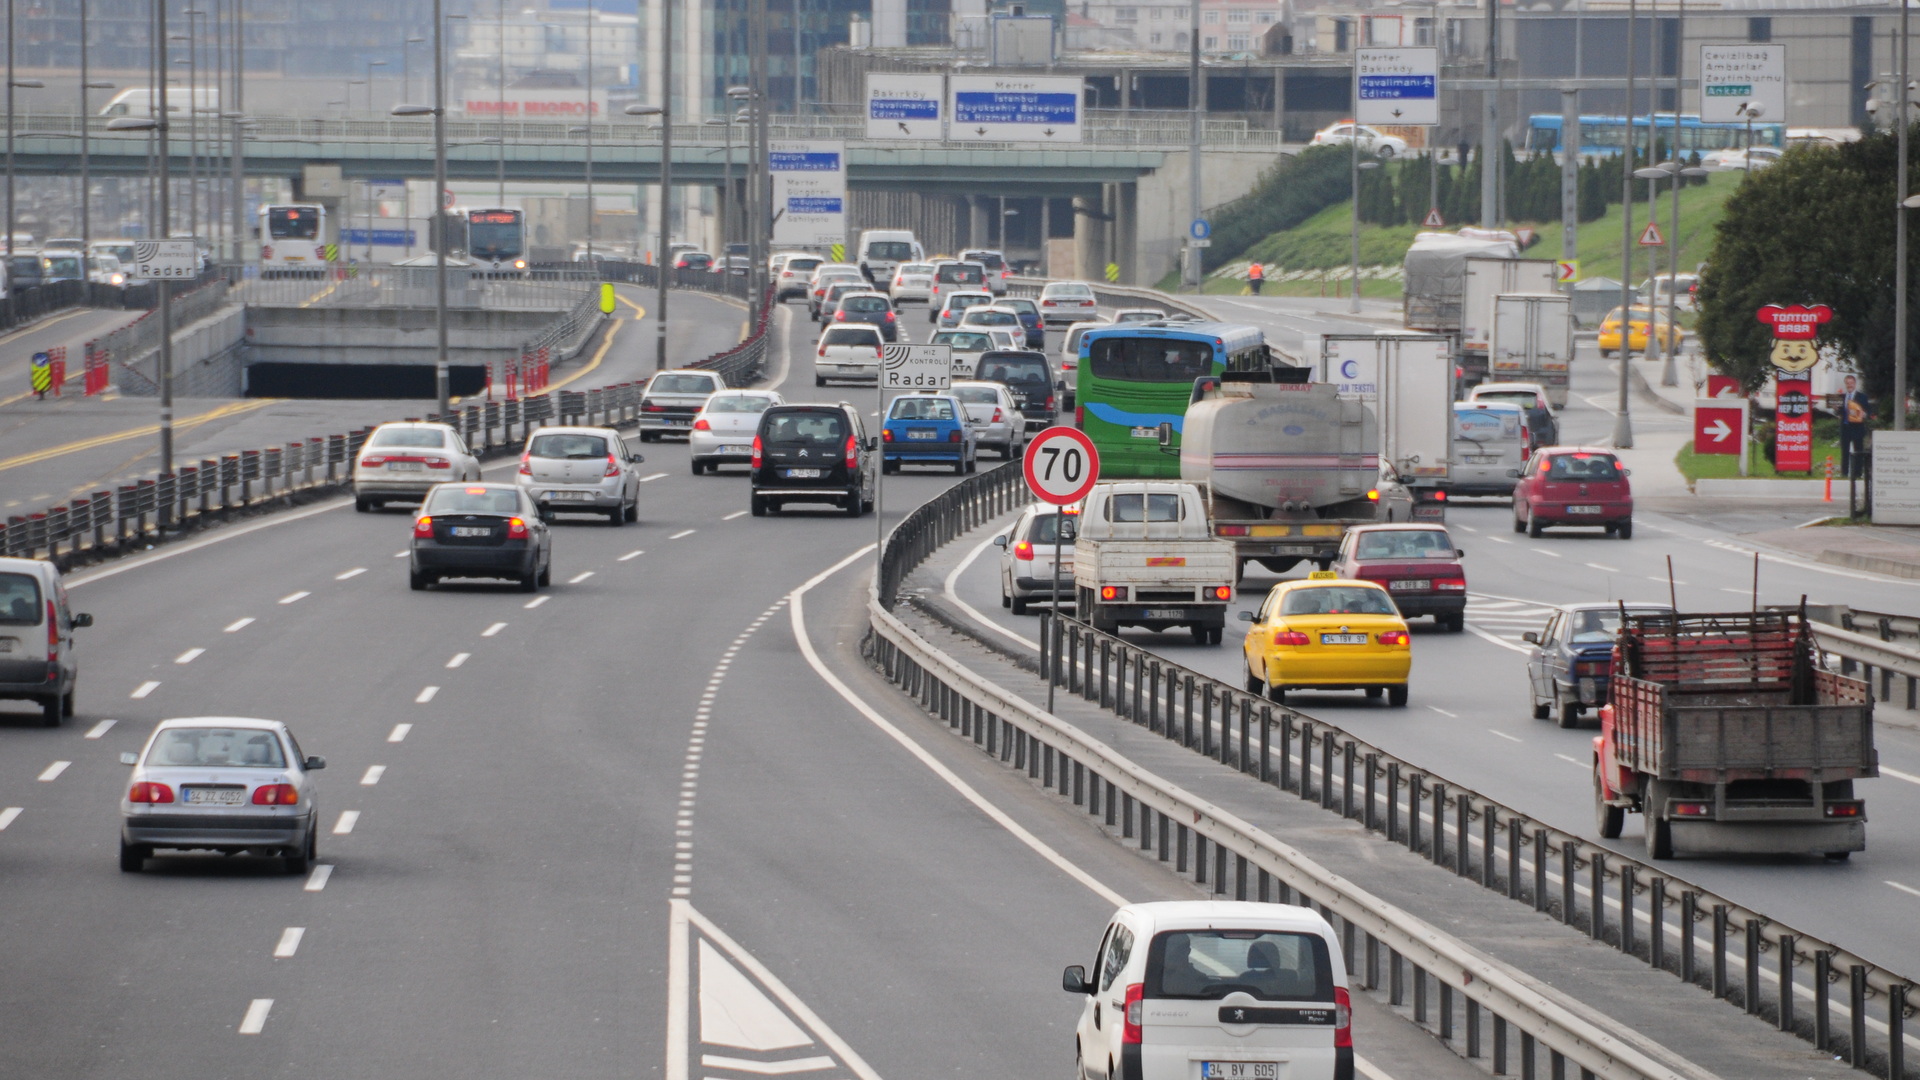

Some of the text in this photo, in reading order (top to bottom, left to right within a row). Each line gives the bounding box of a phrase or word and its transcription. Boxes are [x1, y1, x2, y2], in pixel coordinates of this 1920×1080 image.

[1705, 52, 1768, 61] Cevizlibağ
[1361, 65, 1413, 74] Bakırköy
[1706, 63, 1763, 71] Ambarlar
[1360, 78, 1420, 87] Havalimanı
[1706, 74, 1781, 84] Zeytinburnu
[873, 89, 926, 100] Bakırköy
[1361, 89, 1400, 98] Edirne
[1707, 87, 1750, 95] Ankara
[994, 94, 1038, 103] İstanbul
[466, 101, 519, 114] MMM
[872, 101, 926, 110] Havalimanı
[1021, 104, 1074, 114] Belediyesi
[872, 110, 906, 118] Edirne
[958, 113, 969, 121] Ek
[142, 264, 192, 276] Radar
[1772, 313, 1817, 322] TONTON
[1778, 324, 1810, 333] BABA
[889, 372, 947, 386] Radar
[1778, 420, 1809, 431] Sucuk
[1042, 447, 1082, 482] 70
[191, 791, 201, 799] 34
[206, 791, 217, 800] ZZ
[1210, 1064, 1275, 1076] 34 BV 605
